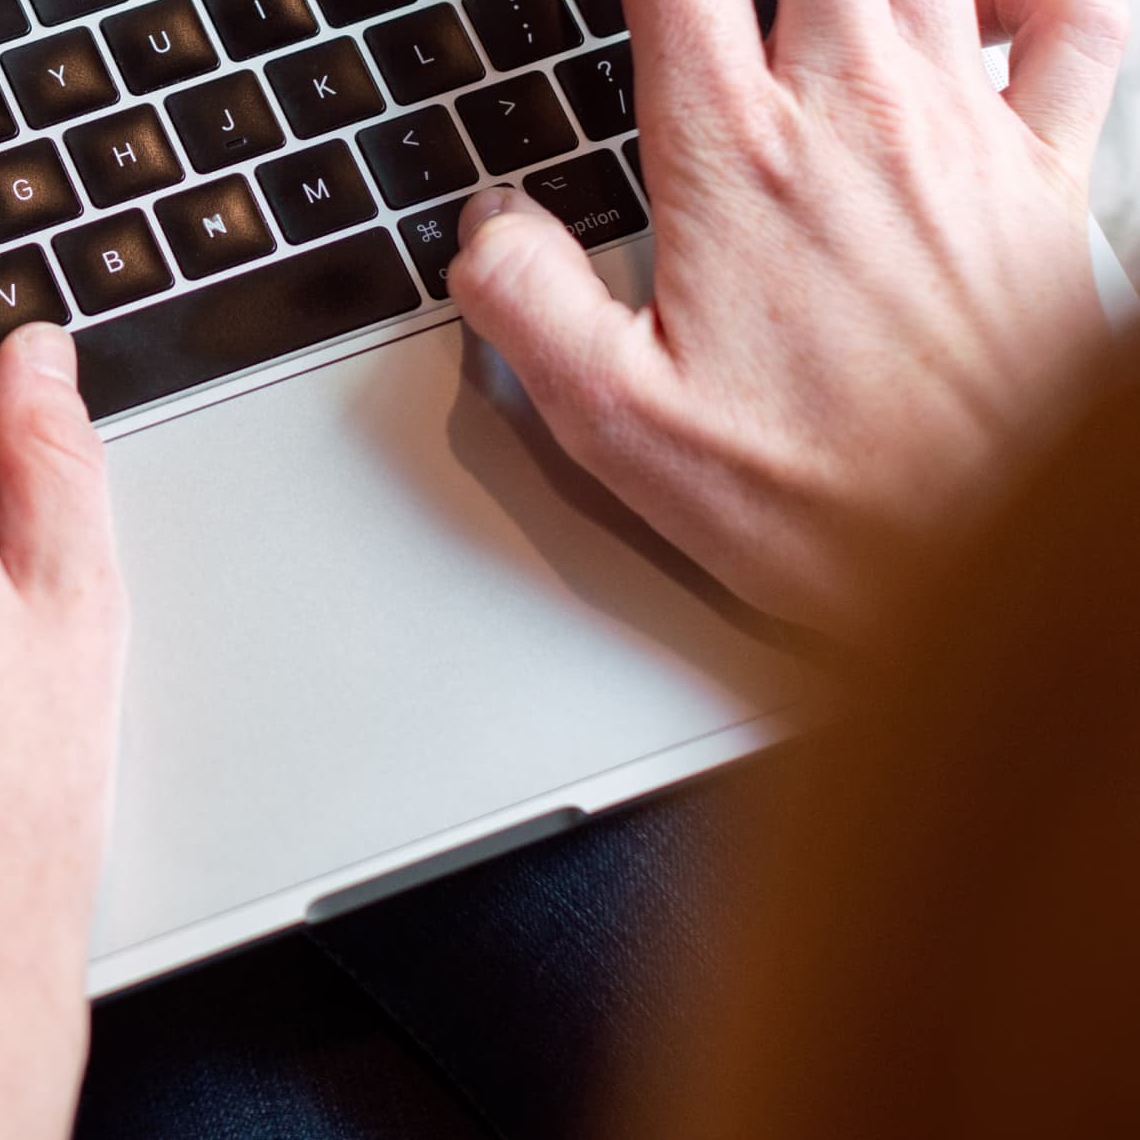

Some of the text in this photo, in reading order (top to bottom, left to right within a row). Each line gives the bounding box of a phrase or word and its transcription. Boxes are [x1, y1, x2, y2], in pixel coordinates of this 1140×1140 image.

[254, 0, 265, 19] I
[149, 31, 171, 53] U
[414, 45, 434, 64] L
[48, 65, 65, 86] Y
[313, 76, 336, 98] K
[222, 109, 234, 131] J
[113, 143, 136, 166] H
[12, 179, 33, 200] G
[303, 178, 330, 203] M
[203, 214, 227, 237] N
[102, 251, 124, 273] B
